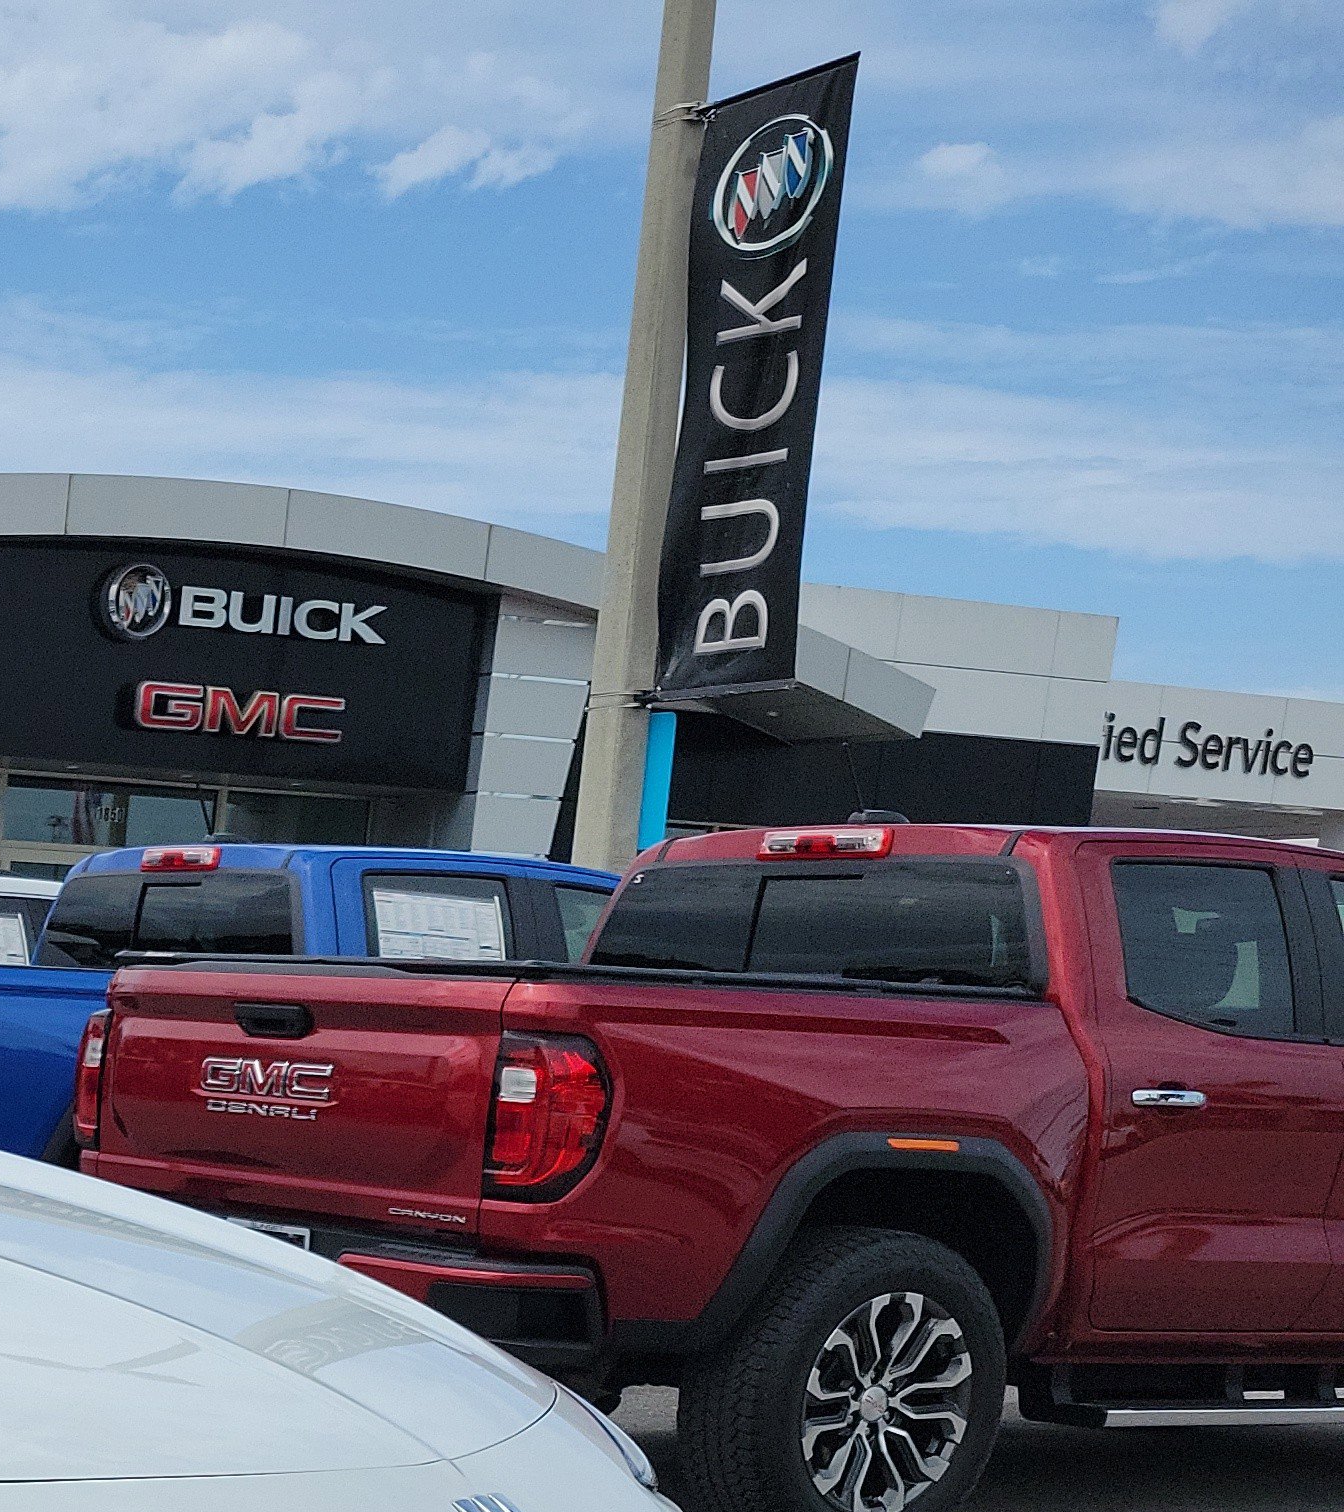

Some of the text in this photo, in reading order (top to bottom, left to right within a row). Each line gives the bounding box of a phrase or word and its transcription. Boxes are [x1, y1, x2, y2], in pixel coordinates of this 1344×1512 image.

[692, 256, 808, 656] BUICK
[178, 584, 389, 645] BUICK
[134, 680, 346, 744] GMC
[1173, 720, 1315, 779] Service
[201, 1056, 333, 1101] GMC
[205, 1100, 317, 1121] DENALI
[387, 1207, 466, 1224] CANYON
